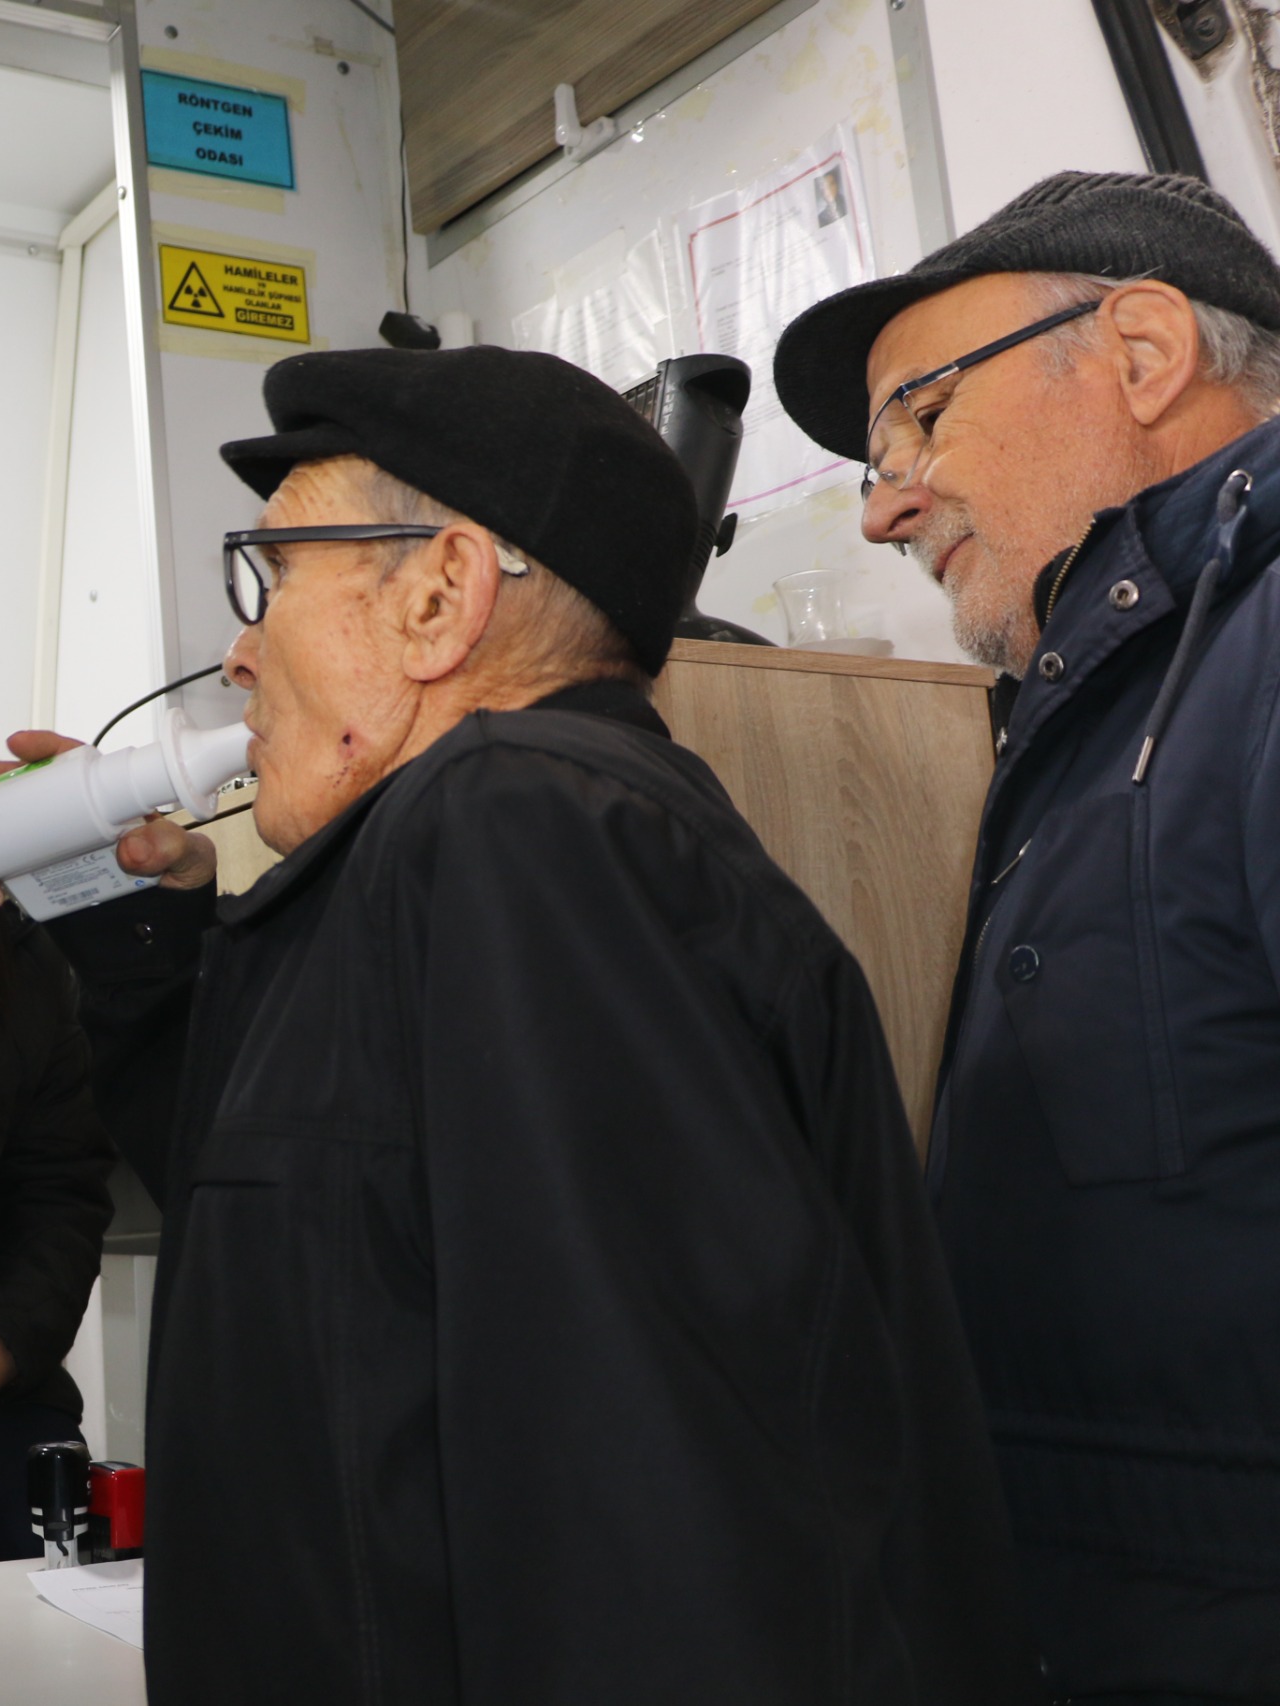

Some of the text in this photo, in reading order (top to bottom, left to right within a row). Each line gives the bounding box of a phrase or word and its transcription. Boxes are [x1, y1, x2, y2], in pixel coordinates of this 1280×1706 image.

[177, 92, 253, 118] RÖNTGEN
[192, 121, 243, 141] ÇEKİM
[195, 147, 243, 166] ODASI
[224, 264, 298, 286] HAMİLELER
[236, 309, 293, 328] GİREMEZ
[660, 382, 676, 436] KUMTE
